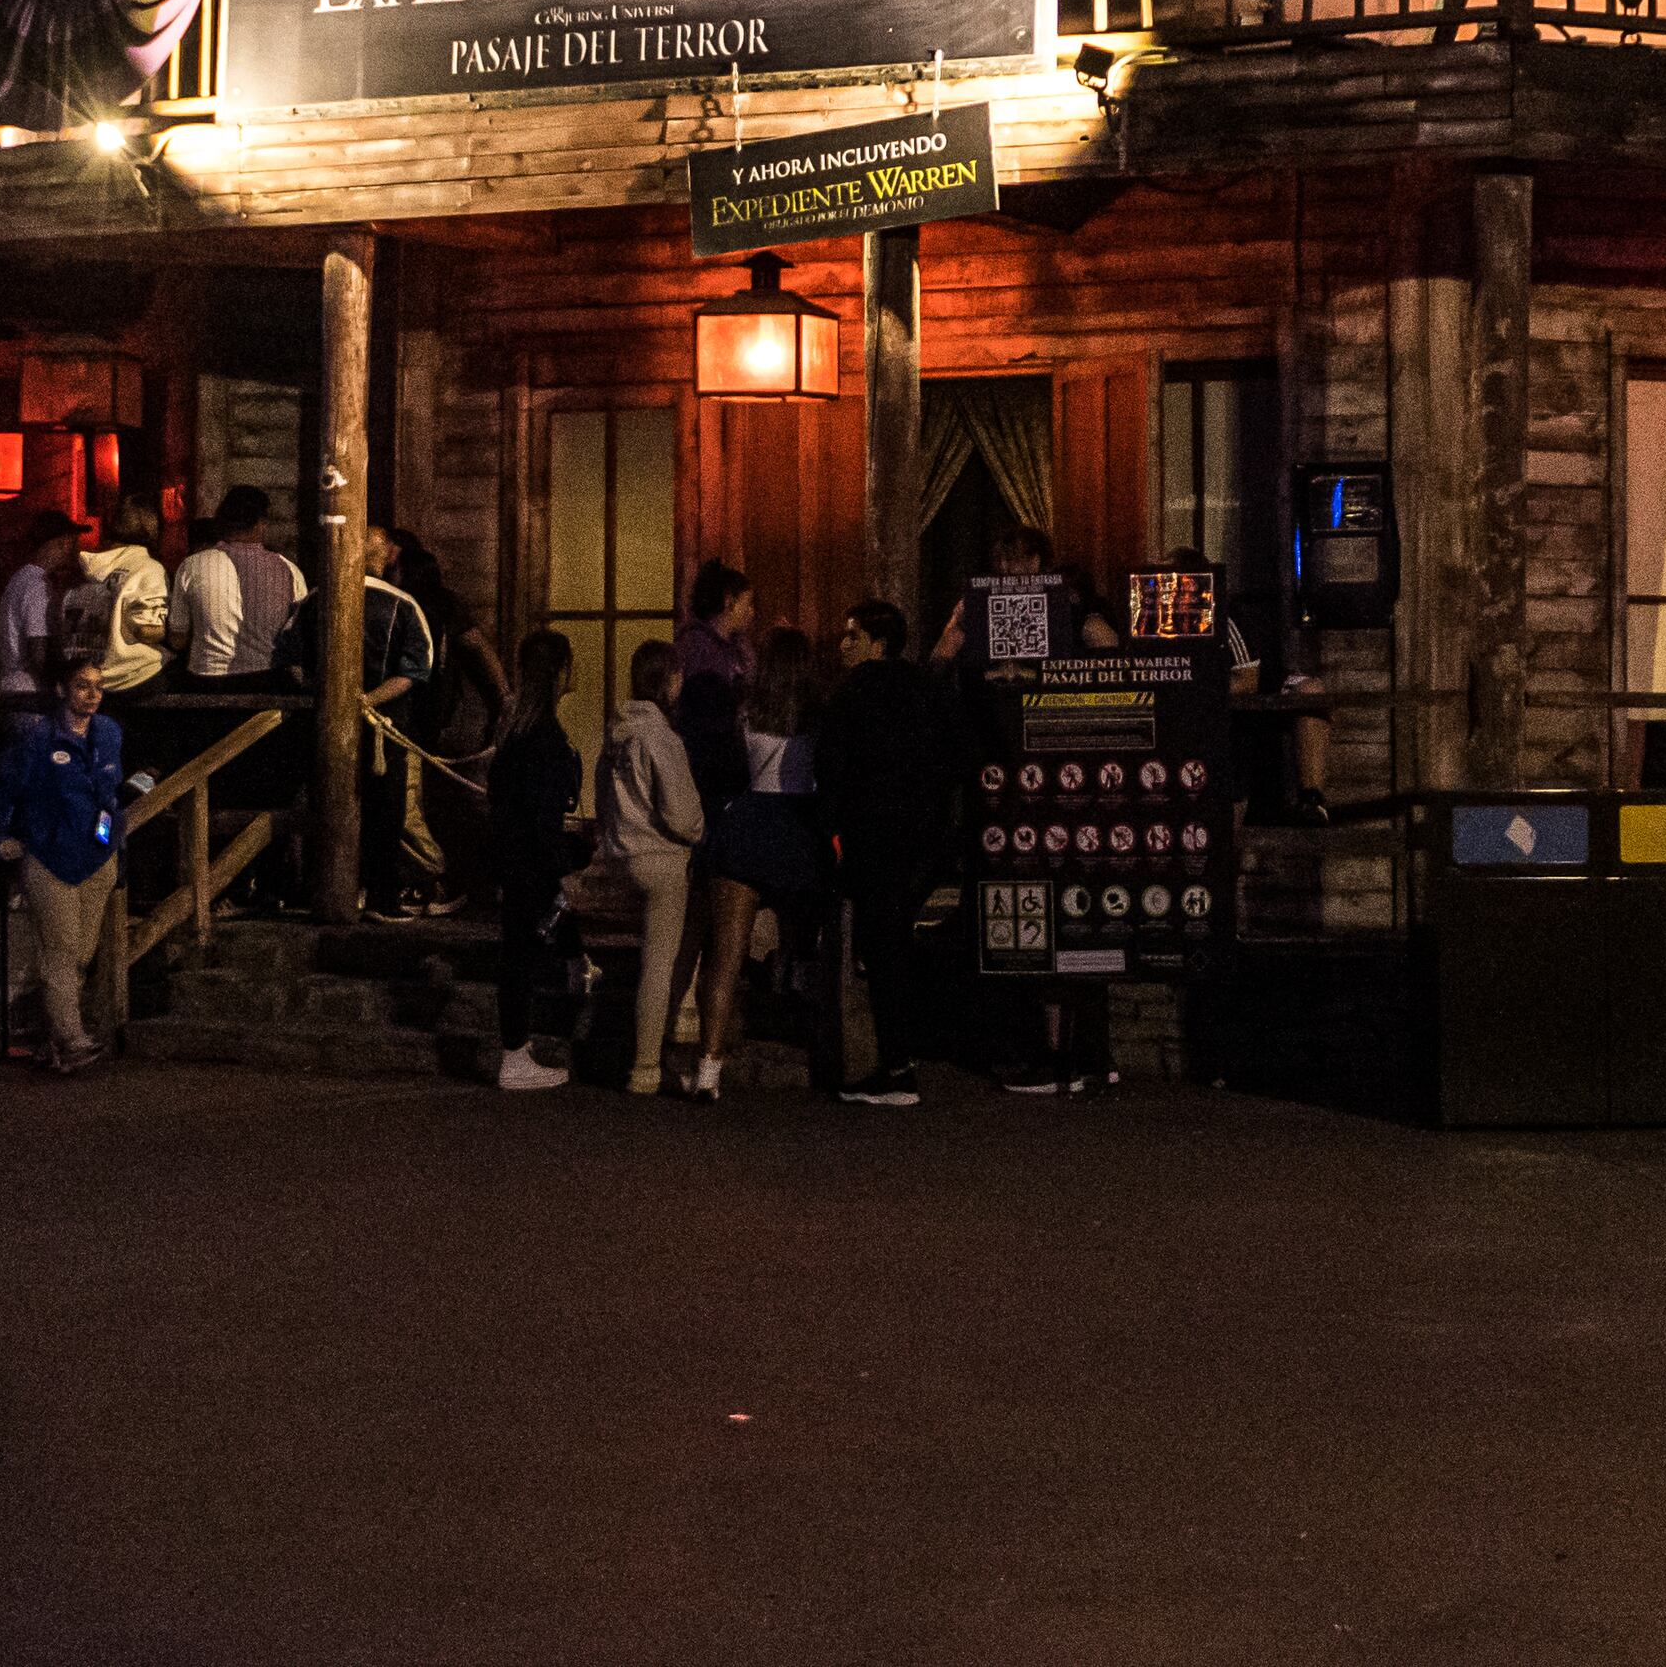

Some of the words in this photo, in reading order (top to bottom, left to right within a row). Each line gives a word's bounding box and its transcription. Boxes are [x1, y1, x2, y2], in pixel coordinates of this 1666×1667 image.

[451, 33, 551, 77] PASAJE
[563, 28, 624, 67] DEL
[633, 17, 770, 62] TERROR
[733, 168, 744, 186] Y
[749, 156, 815, 184] AHORA
[820, 132, 947, 171] INCLUYENDO
[711, 179, 864, 227] EXPEDIENTE
[867, 159, 978, 200] WARREN
[817, 210, 837, 223] POR
[852, 195, 925, 220] DEMONIO
[1041, 658, 1131, 670] EXPEDIENTES
[1133, 655, 1192, 669] WARREN
[1042, 671, 1094, 685] PASAJE
[1097, 670, 1124, 683] DEL
[1131, 668, 1193, 682] TERROR
